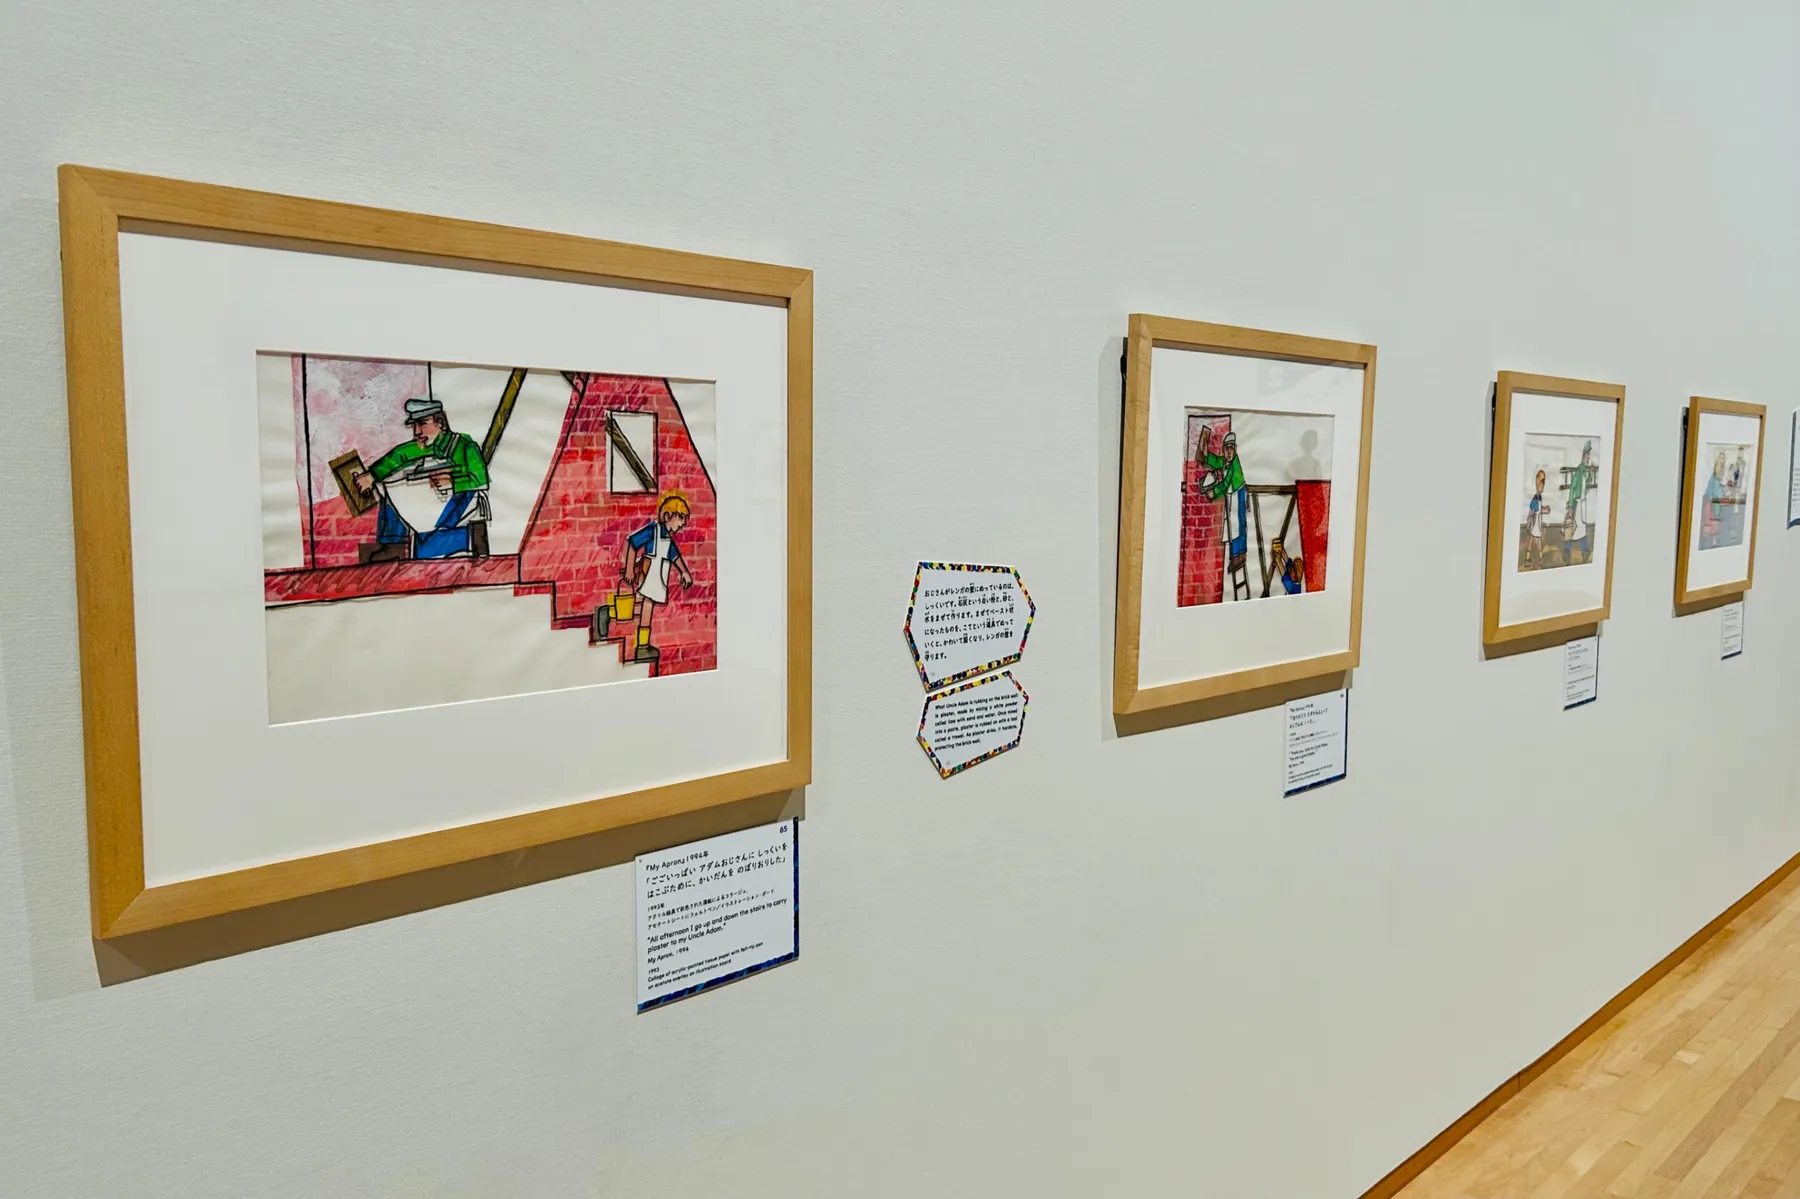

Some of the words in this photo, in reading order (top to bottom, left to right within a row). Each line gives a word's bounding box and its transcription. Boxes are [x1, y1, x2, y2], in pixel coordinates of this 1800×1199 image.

[780, 825, 788, 833] 65
[646, 867, 696, 884] 「ごごいっぱい
[700, 852, 754, 872] アダムおじさんに
[758, 843, 787, 857] しっくいを
[648, 880, 695, 899] はこぶために、
[699, 869, 734, 884] かいだんを
[737, 856, 785, 873] のぼりおりした」
[660, 928, 689, 940] afternoon
[712, 916, 722, 924] and
[724, 912, 738, 921] down
[750, 905, 765, 913] stairs
[773, 898, 787, 906] carry
[648, 942, 669, 954] plaster
[688, 931, 705, 940] Uncle
[676, 946, 689, 954] 1994
[648, 974, 664, 982] Collage
[655, 979, 672, 987] acetate
[719, 958, 731, 966] board
